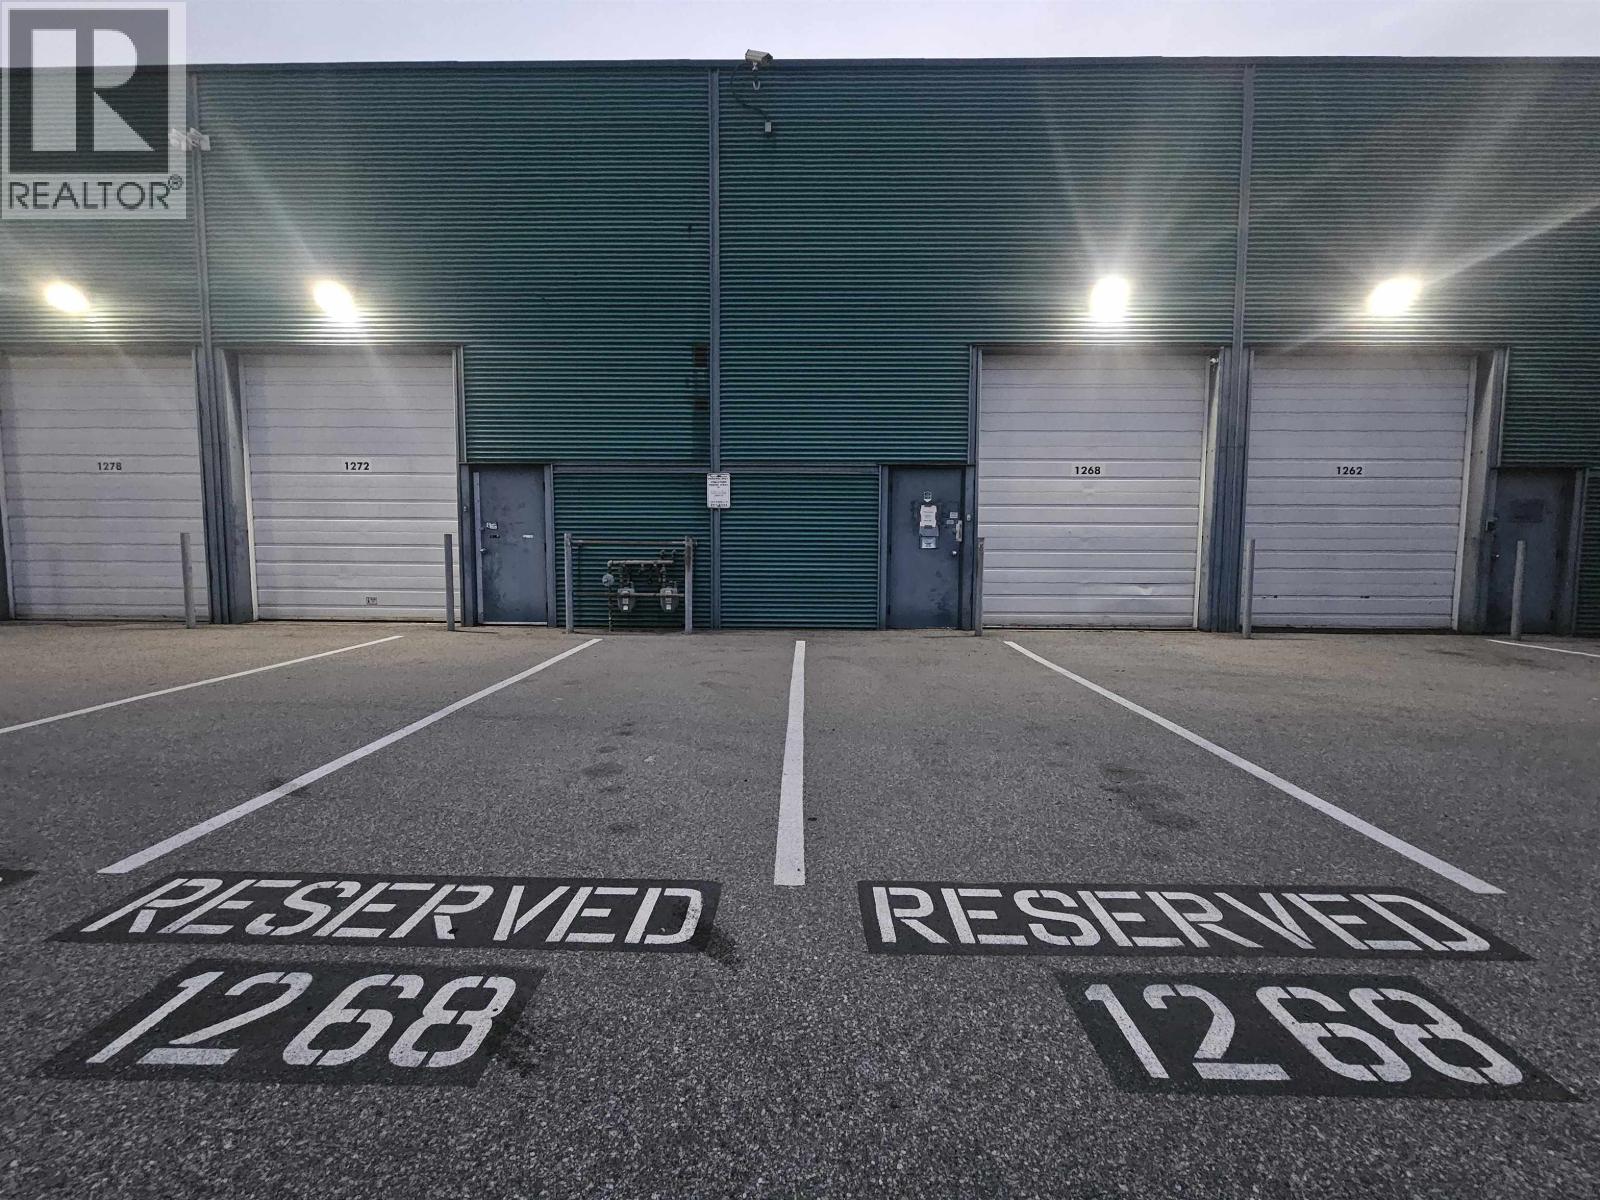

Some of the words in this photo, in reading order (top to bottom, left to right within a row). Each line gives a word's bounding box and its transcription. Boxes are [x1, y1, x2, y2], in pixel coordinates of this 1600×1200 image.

[97, 461, 122, 471] 1278
[344, 461, 370, 471] 1272
[1074, 466, 1101, 475] 1268
[1336, 466, 1363, 475] 1262
[82, 878, 704, 946] RESERVED
[871, 886, 1491, 952] RESERVED
[86, 970, 518, 1068] 1268
[1084, 983, 1524, 1085] 1268
